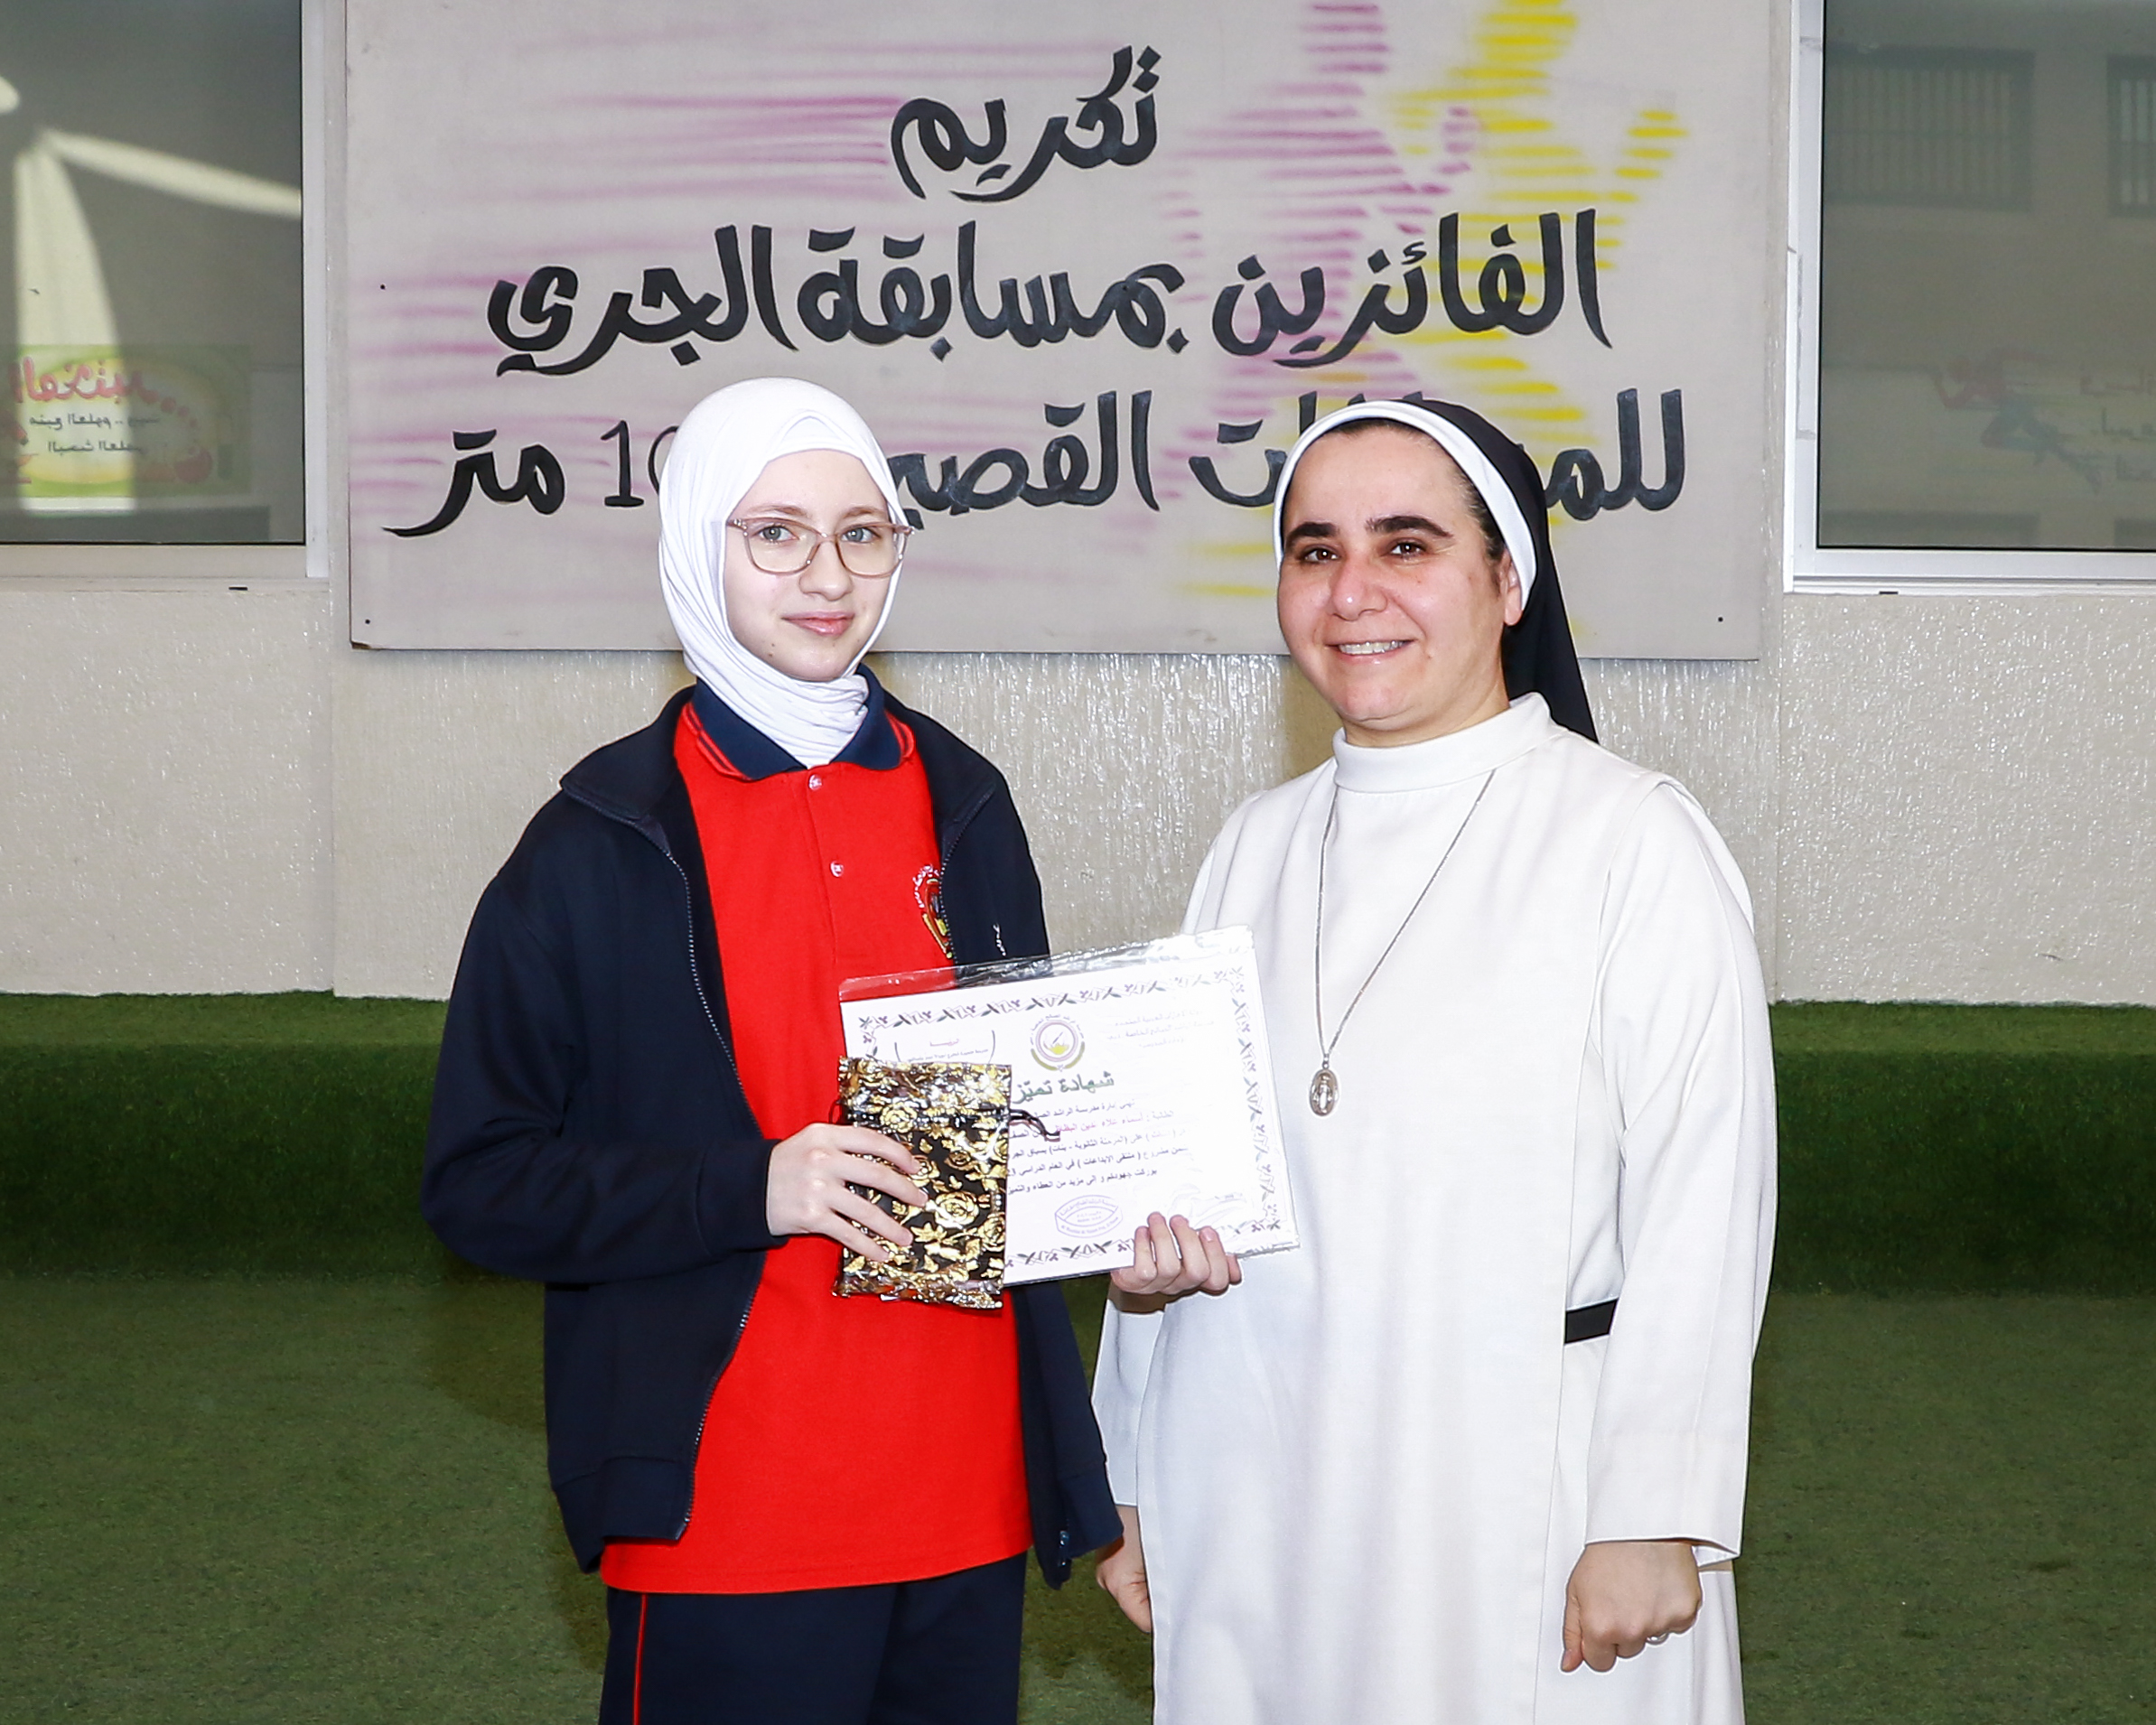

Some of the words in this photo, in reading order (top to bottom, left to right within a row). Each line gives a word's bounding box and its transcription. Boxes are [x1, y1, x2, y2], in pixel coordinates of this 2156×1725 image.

[891, 45, 1162, 203] تكريم
[487, 224, 798, 378] الجري
[798, 220, 1189, 361] بمسابقة
[1212, 209, 1613, 368] الفائزين
[383, 429, 566, 538] متر
[1058, 1070, 1115, 1094] شهادة
